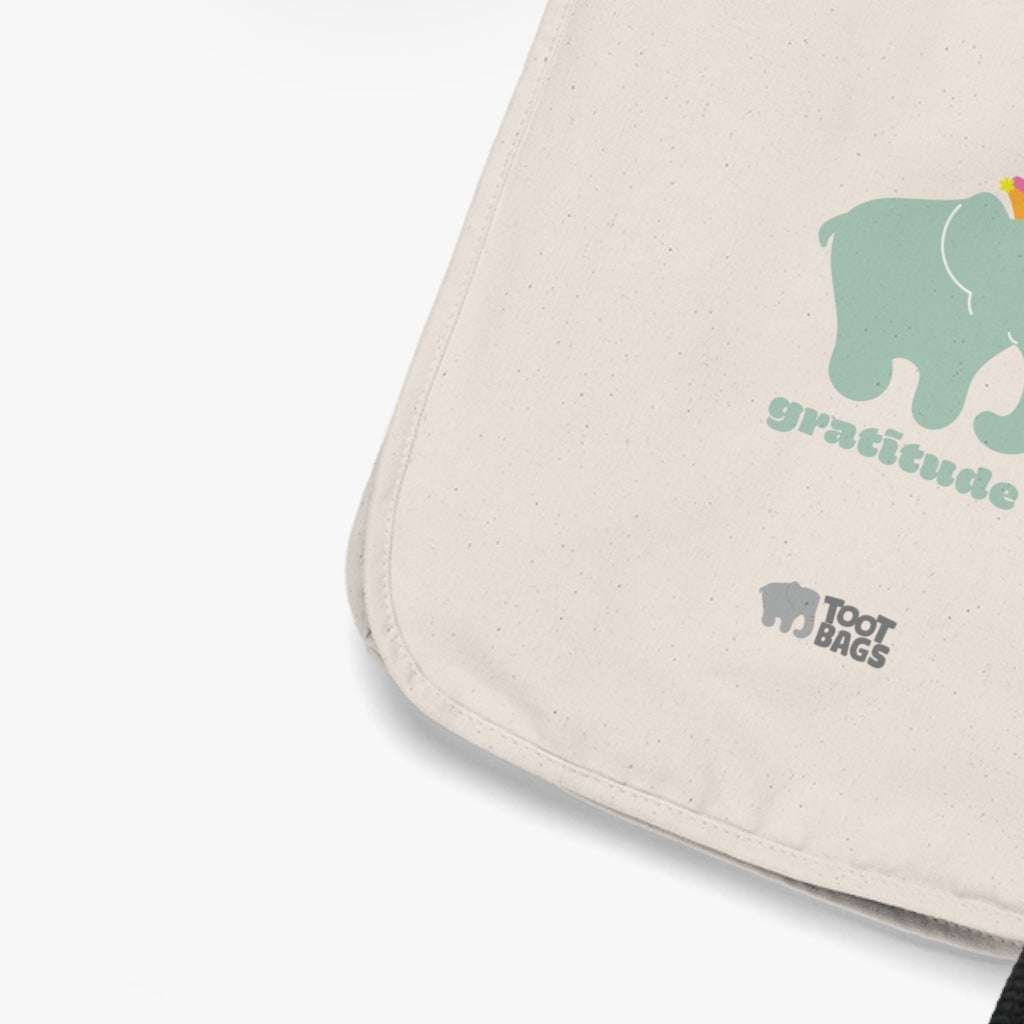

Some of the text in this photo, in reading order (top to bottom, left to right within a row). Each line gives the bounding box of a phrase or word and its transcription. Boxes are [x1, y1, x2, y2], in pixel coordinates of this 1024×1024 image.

[766, 396, 1019, 511] gratitude
[824, 595, 897, 644] TOOT
[813, 622, 890, 669] BAGS
